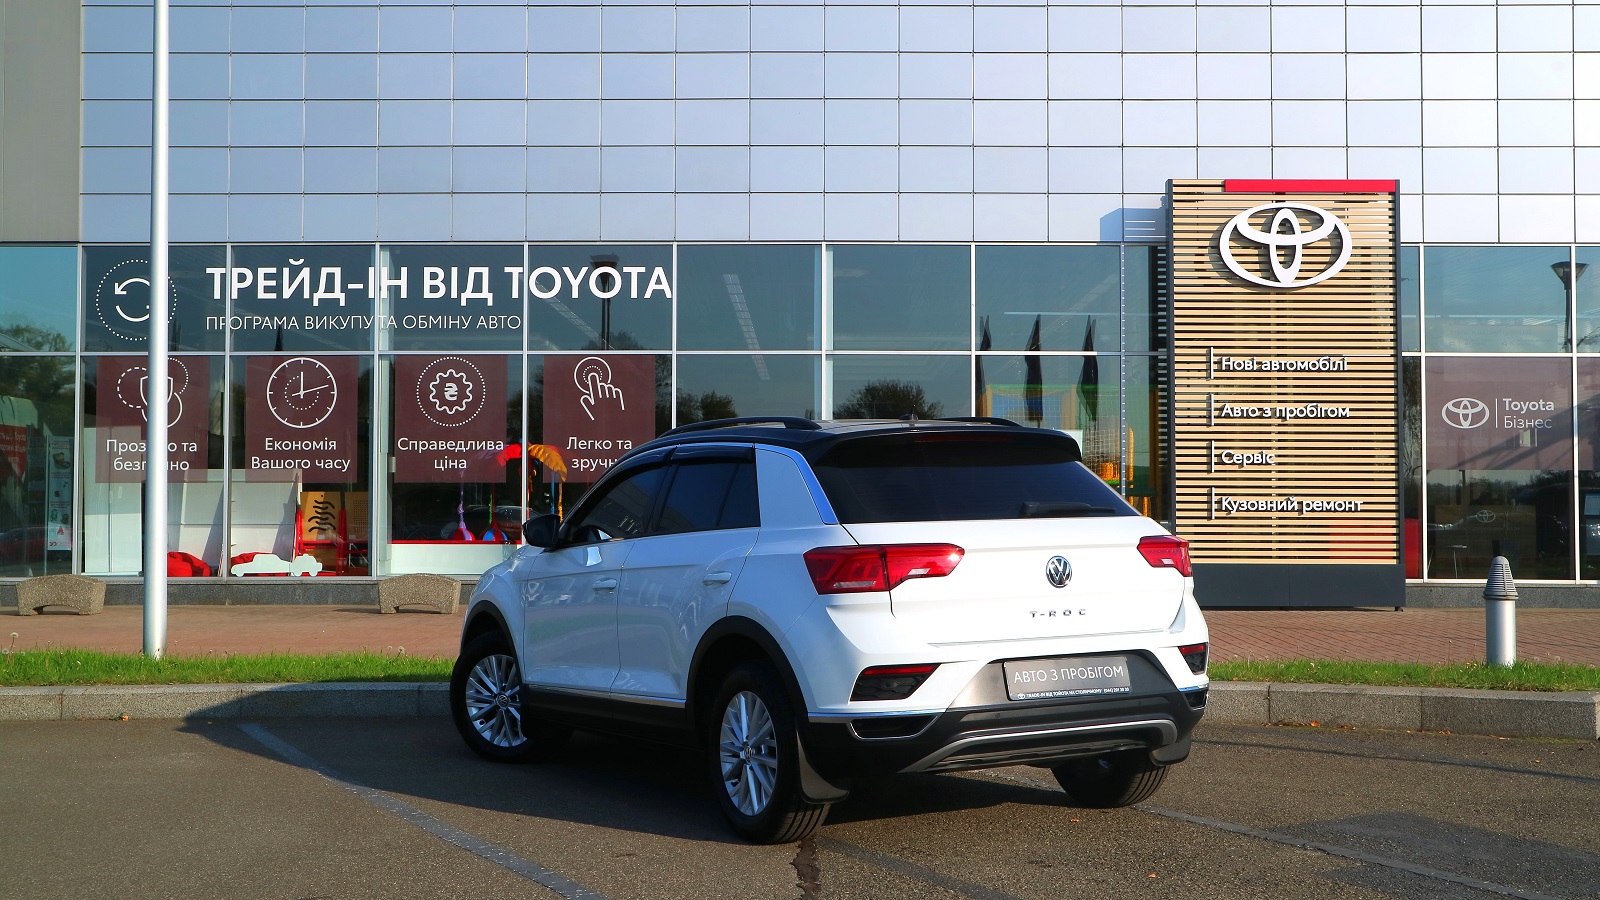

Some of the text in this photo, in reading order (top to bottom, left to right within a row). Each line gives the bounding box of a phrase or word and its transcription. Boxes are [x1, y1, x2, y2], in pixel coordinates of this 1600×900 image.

[206, 258, 673, 307] ТРЕЙД-ІН ВІД TOYOTA
[206, 315, 522, 330] ПРОГРАМА ВИКУПУ ТА ОБМІНУ АВТО
[1221, 356, 1348, 371] Нові автомобілі
[1221, 402, 1350, 421] Авто з пробігом
[1502, 398, 1555, 414] Toyota
[1504, 415, 1553, 429] Бізнес
[106, 439, 197, 455] Прозо та
[265, 437, 337, 451] Економія
[397, 437, 504, 454] Справедлива
[566, 436, 633, 450] Легко та
[251, 456, 351, 472] Вашого часу
[434, 456, 467, 471] ціна
[1221, 450, 1276, 466] Сервіс
[1221, 496, 1364, 514] Кузовний ремонт
[1014, 669, 1047, 684] АВТО
[1060, 665, 1124, 681] ПРОБІГОМ
